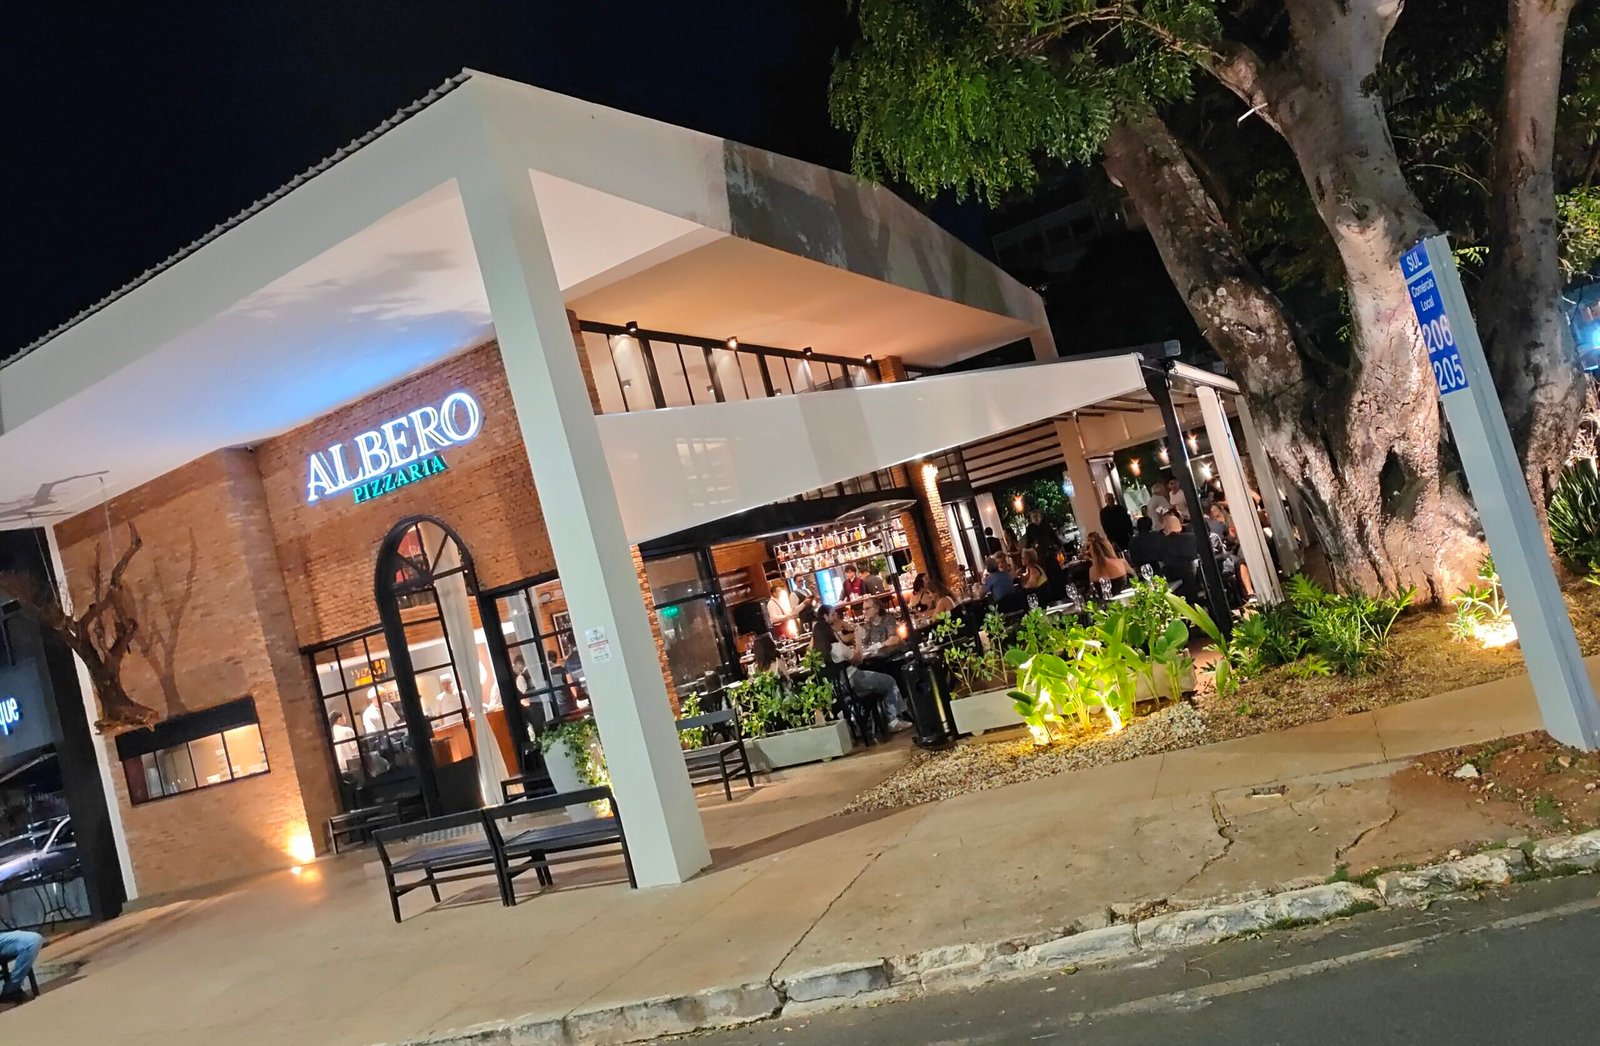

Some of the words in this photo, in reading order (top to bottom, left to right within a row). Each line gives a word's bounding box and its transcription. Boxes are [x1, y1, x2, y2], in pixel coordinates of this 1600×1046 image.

[1406, 252, 1422, 272] SUL
[1420, 295, 1435, 311] Local
[1434, 353, 1465, 391] 205
[307, 392, 479, 501] ALBERO
[353, 455, 445, 503] PIZZARIA
